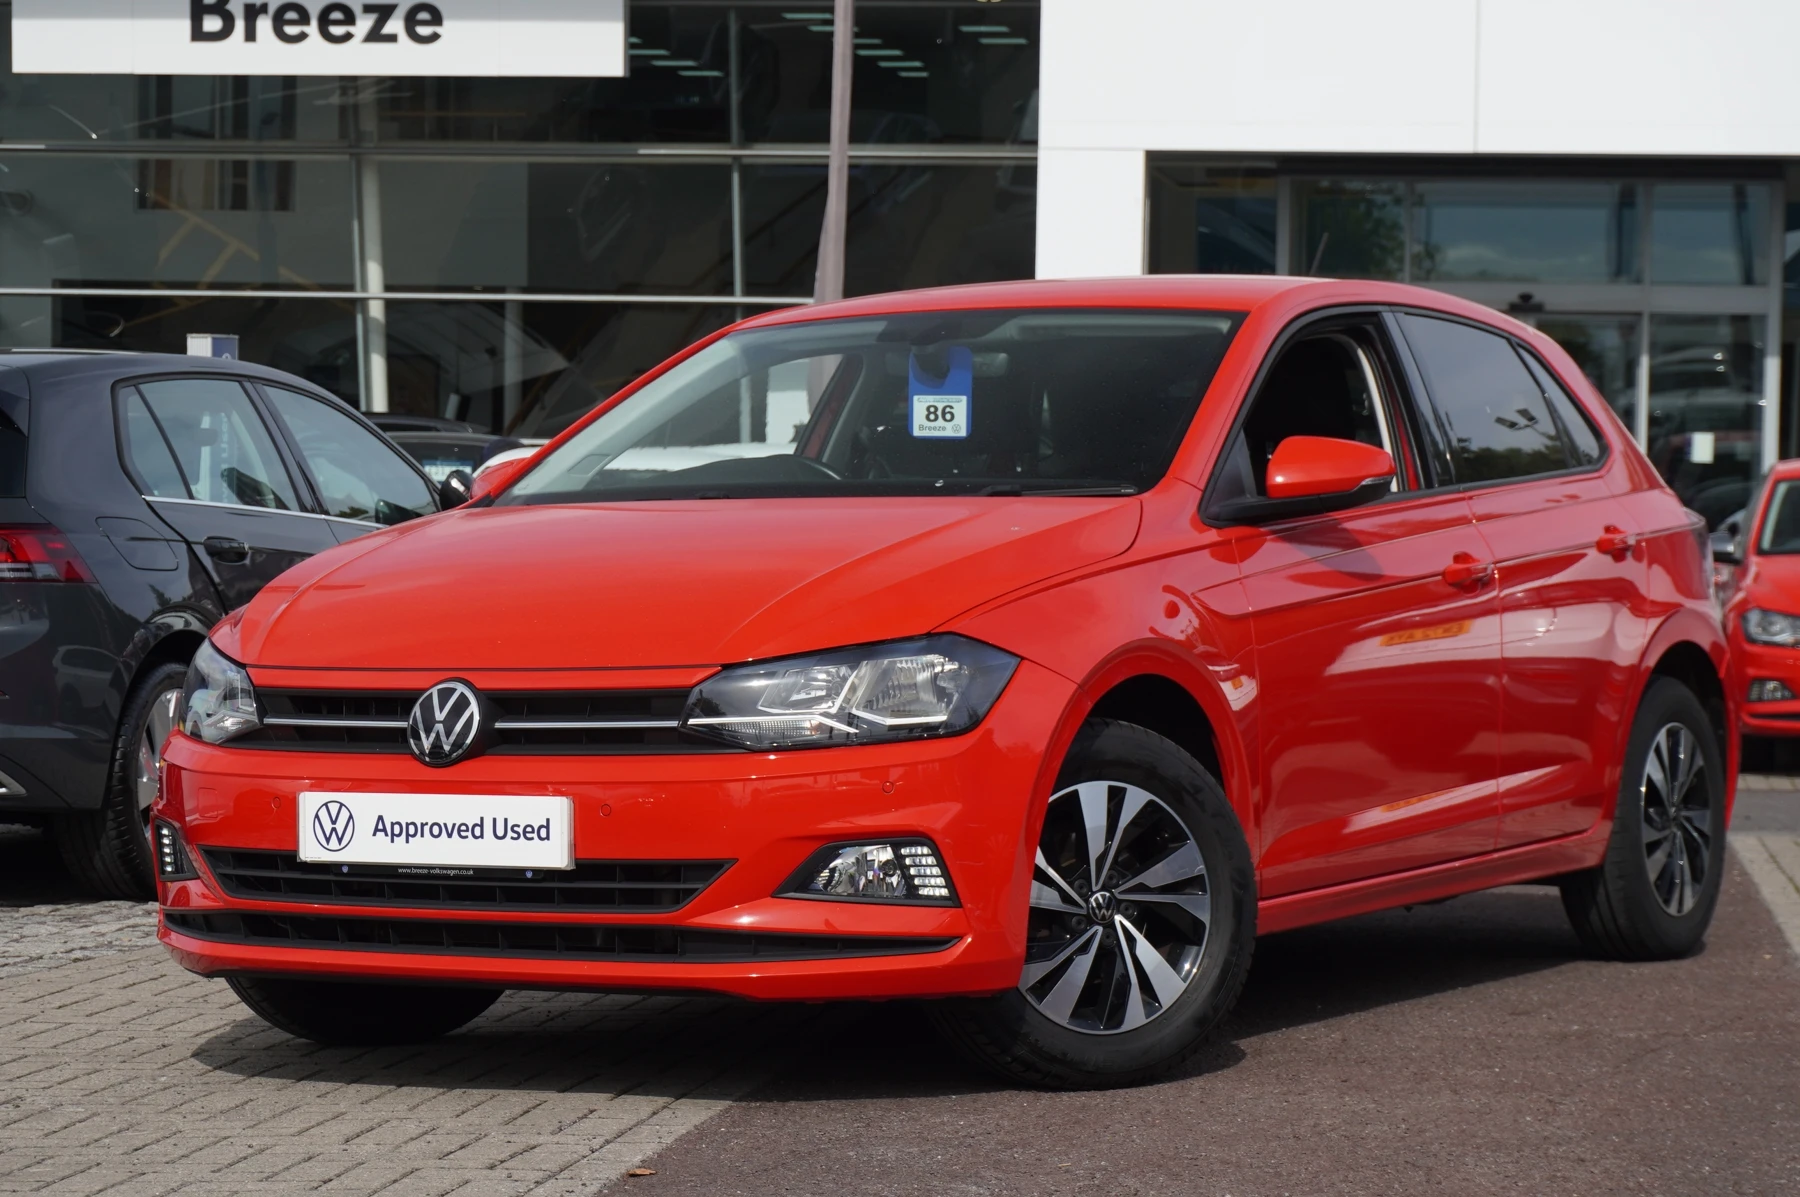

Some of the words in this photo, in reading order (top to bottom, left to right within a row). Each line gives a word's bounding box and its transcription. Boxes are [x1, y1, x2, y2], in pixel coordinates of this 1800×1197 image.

[190, 0, 443, 44] Breeze
[925, 404, 955, 423] 86
[918, 424, 947, 432] Breeze
[372, 814, 485, 843] Approved
[492, 817, 551, 841] Used
[398, 867, 474, 876] www.breeze-volkswagen.co.uk
